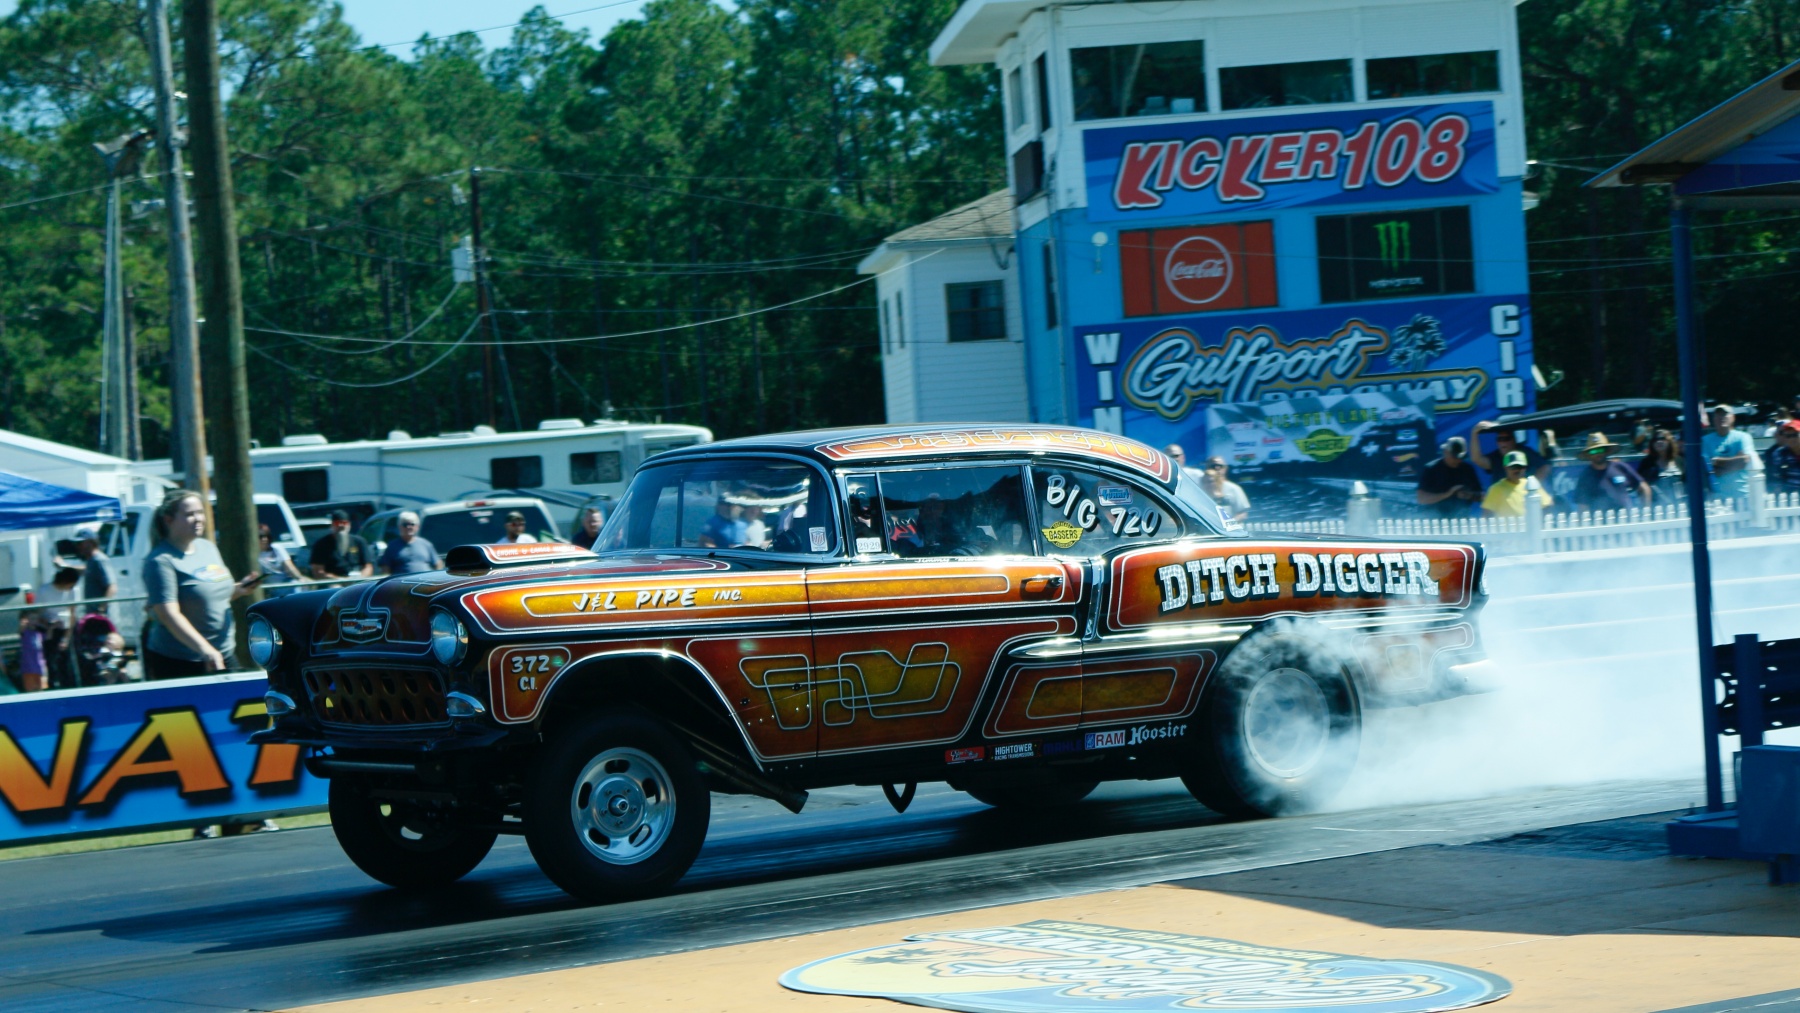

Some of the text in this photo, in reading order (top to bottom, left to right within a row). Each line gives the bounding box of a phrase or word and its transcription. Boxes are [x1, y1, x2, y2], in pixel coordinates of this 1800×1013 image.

[1132, 329, 1377, 408] Gulfport
[1338, 408, 1377, 423] LANE
[1047, 474, 1161, 537] BIG 720
[1049, 529, 1078, 540] GASSERS
[1158, 551, 1440, 612] DITCH DIGGER
[573, 588, 743, 612] J&L PIPE INC.
[511, 655, 550, 674] 372
[1095, 732, 1125, 746] RAM
[1128, 721, 1188, 746] Hoosier
[995, 743, 1033, 755] HIGHTOWER
[958, 930, 1284, 972] DRAGWAY
